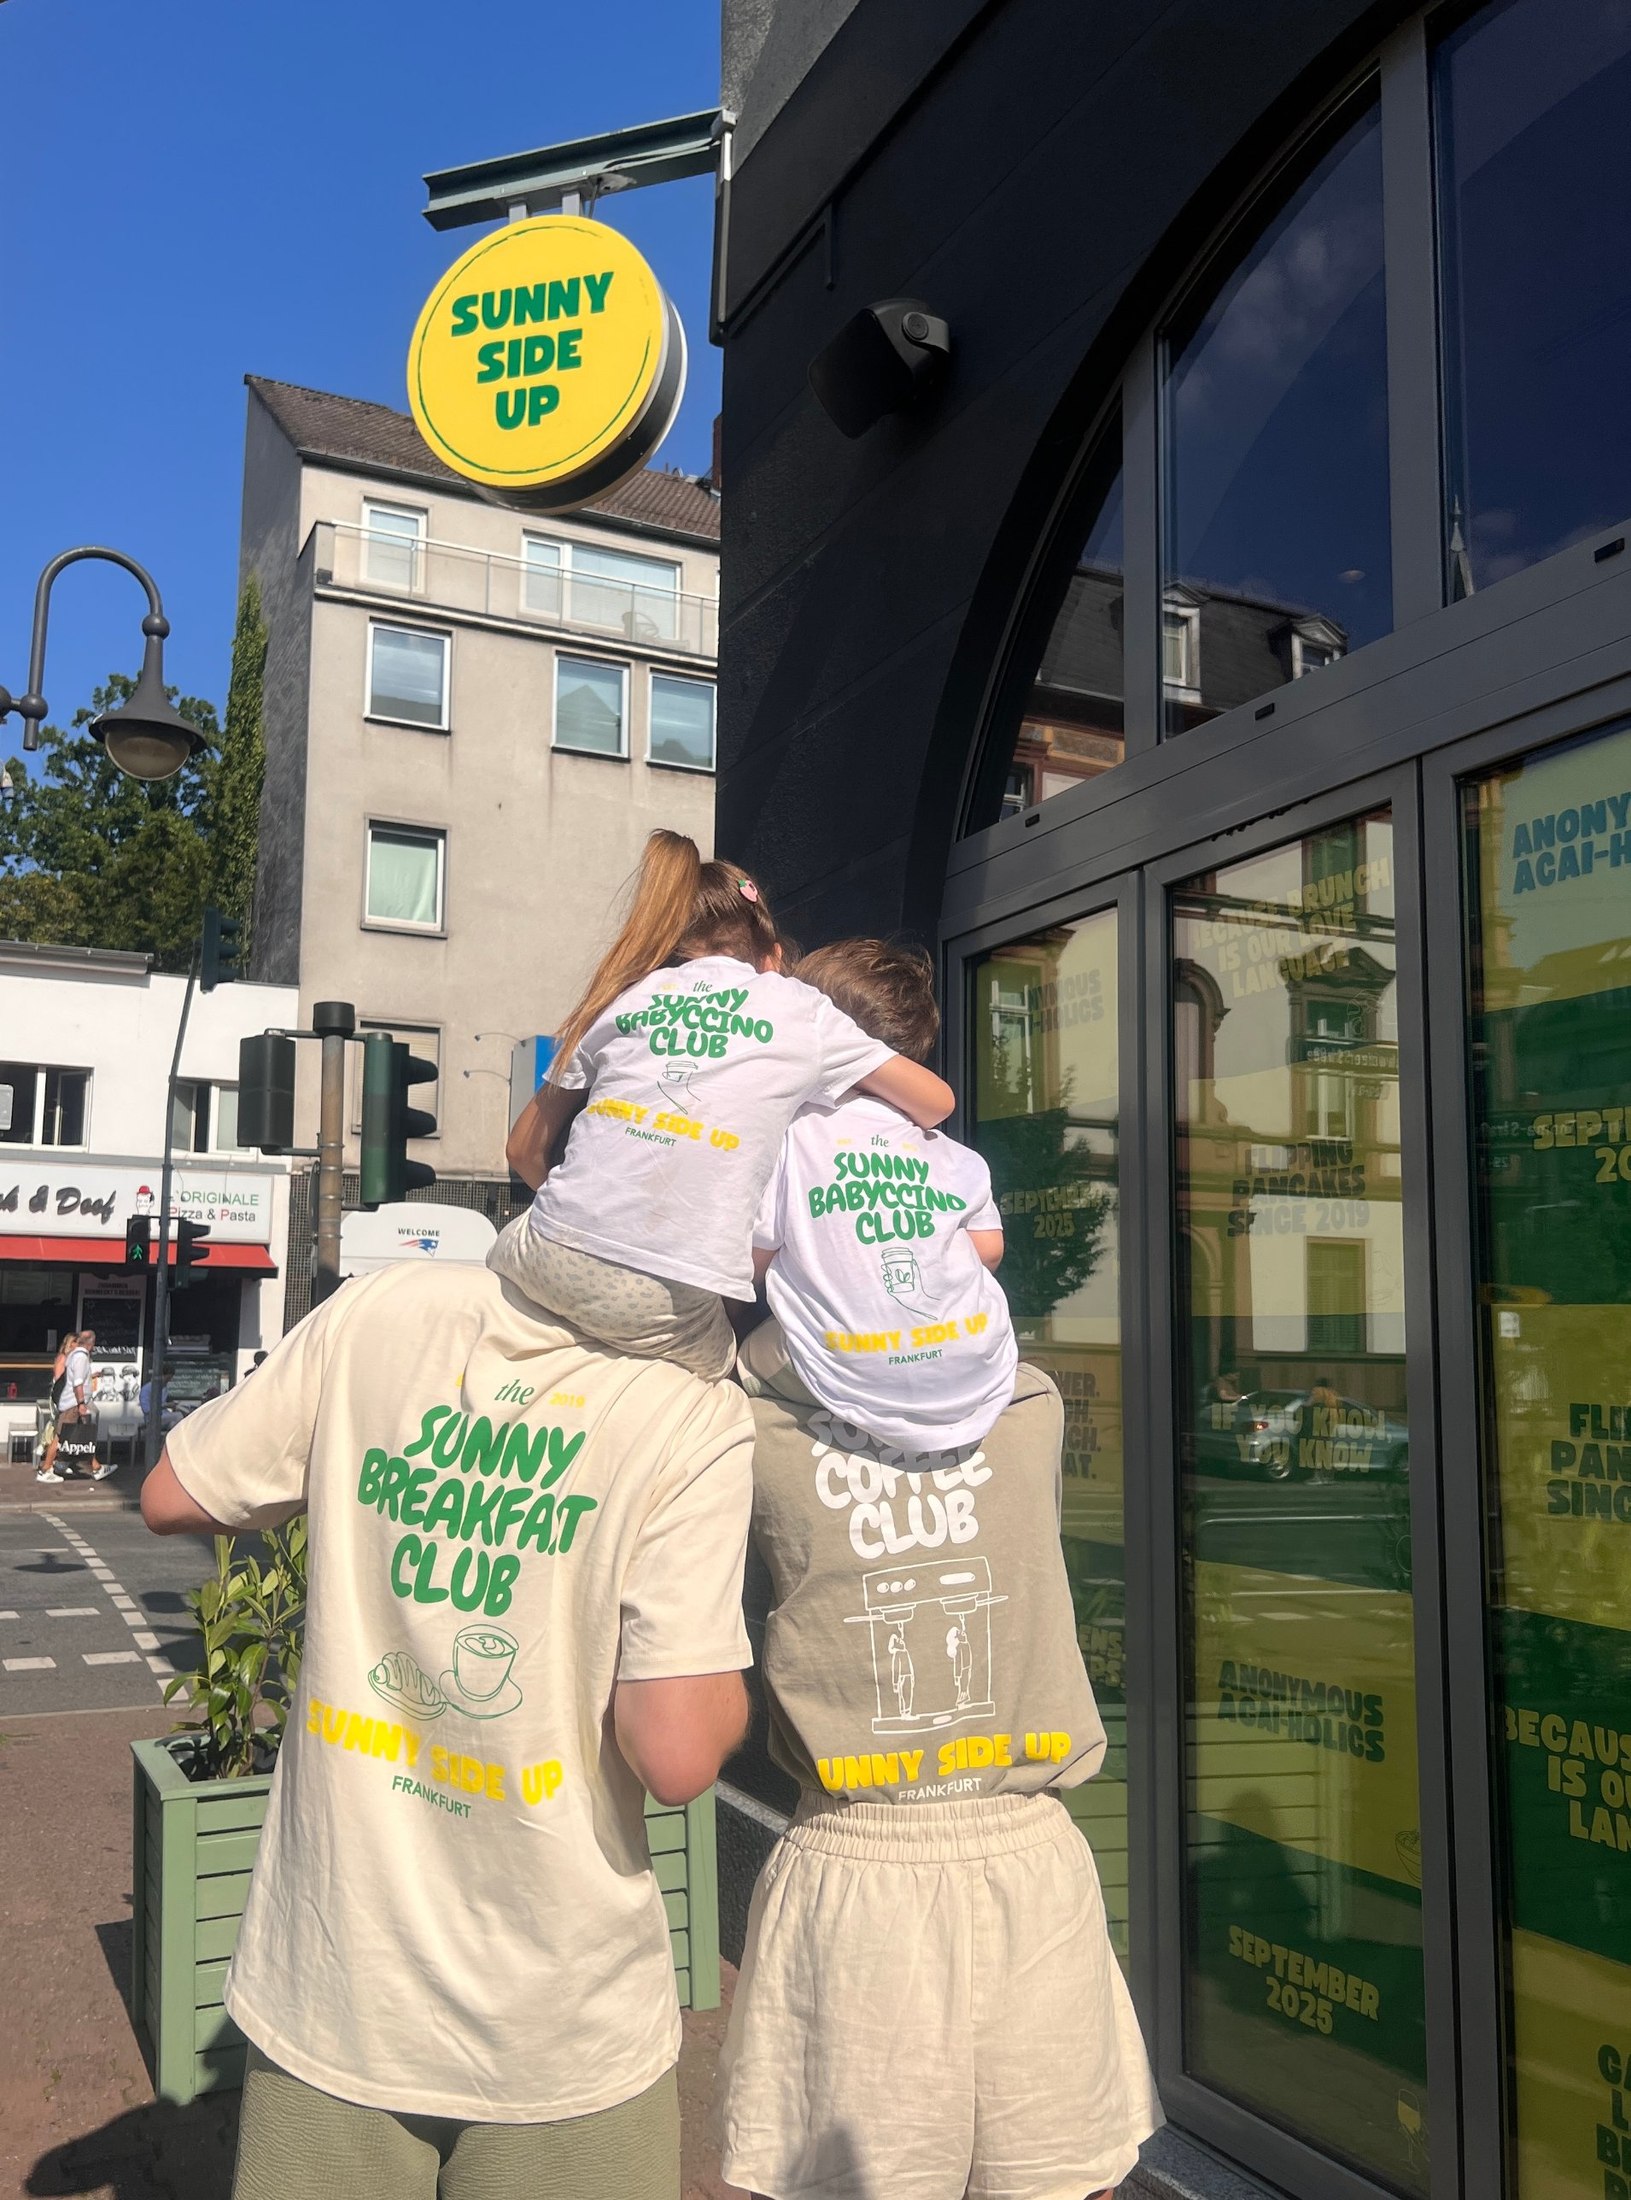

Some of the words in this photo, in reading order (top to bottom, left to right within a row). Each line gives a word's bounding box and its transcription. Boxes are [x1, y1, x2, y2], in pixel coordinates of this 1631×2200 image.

[451, 271, 614, 337] SUNNY
[477, 328, 583, 384] SIDE
[495, 385, 560, 430] UP
[1286, 856, 1391, 916] BRUNCH
[1218, 940, 1240, 974] IS
[1248, 922, 1291, 963] OUR
[693, 981, 713, 993] the
[615, 1004, 774, 1044] BABYCCINO
[649, 1026, 729, 1058] CLUB
[624, 1126, 677, 1149] FRANKFURT
[653, 1112, 705, 1141] SIDE
[709, 1127, 741, 1152] UP
[871, 1134, 889, 1148] the
[833, 1152, 929, 1185] SUNNY
[1245, 1139, 1353, 1176] FLIPPING
[56, 1187, 116, 1225] Doof
[808, 1180, 967, 1219] BABYCCINO
[1232, 1165, 1366, 1207] PANCAKES
[207, 1208, 216, 1220] &
[221, 1209, 256, 1222] Pasta
[398, 1227, 440, 1237] WELCOME
[855, 1211, 935, 1244] CLUB
[1033, 1212, 1075, 1239] 2025
[1227, 1204, 1307, 1238] SINCE
[1316, 1200, 1370, 1231] 2019
[824, 1330, 901, 1354] SUNNY
[910, 1322, 960, 1346] SIDE
[964, 1312, 988, 1335] UP
[888, 1349, 942, 1366] FRANKFURT
[494, 1379, 535, 1405] the
[1211, 1402, 1236, 1431] IF
[1250, 1404, 1301, 1434] YOU
[404, 1404, 586, 1490] SUNNY
[1236, 1434, 1289, 1464] YOU
[1300, 1438, 1372, 1473] KNOW
[815, 1440, 993, 1509] COFFEE
[358, 1448, 598, 1556] BREAKFAT
[850, 1490, 979, 1559] CLUB
[390, 1534, 521, 1617] CLUB
[1219, 1660, 1384, 1727] ANONYMOUS
[1218, 1692, 1385, 1763] ACAI-HOLICS
[306, 1698, 422, 1769] SUNNY
[429, 1745, 506, 1802] SIDE
[521, 1759, 564, 1806] UP
[817, 1750, 924, 1790] UNNY
[938, 1733, 1013, 1777] SIDE
[1025, 1731, 1072, 1764] UP
[391, 1775, 472, 1818] FRANKFURT
[898, 1777, 982, 1801] FRANKFURT
[1547, 1755, 1587, 1797] IS
[1228, 1925, 1379, 2022] SEPTEMBER
[1266, 1976, 1334, 2036] 2025
